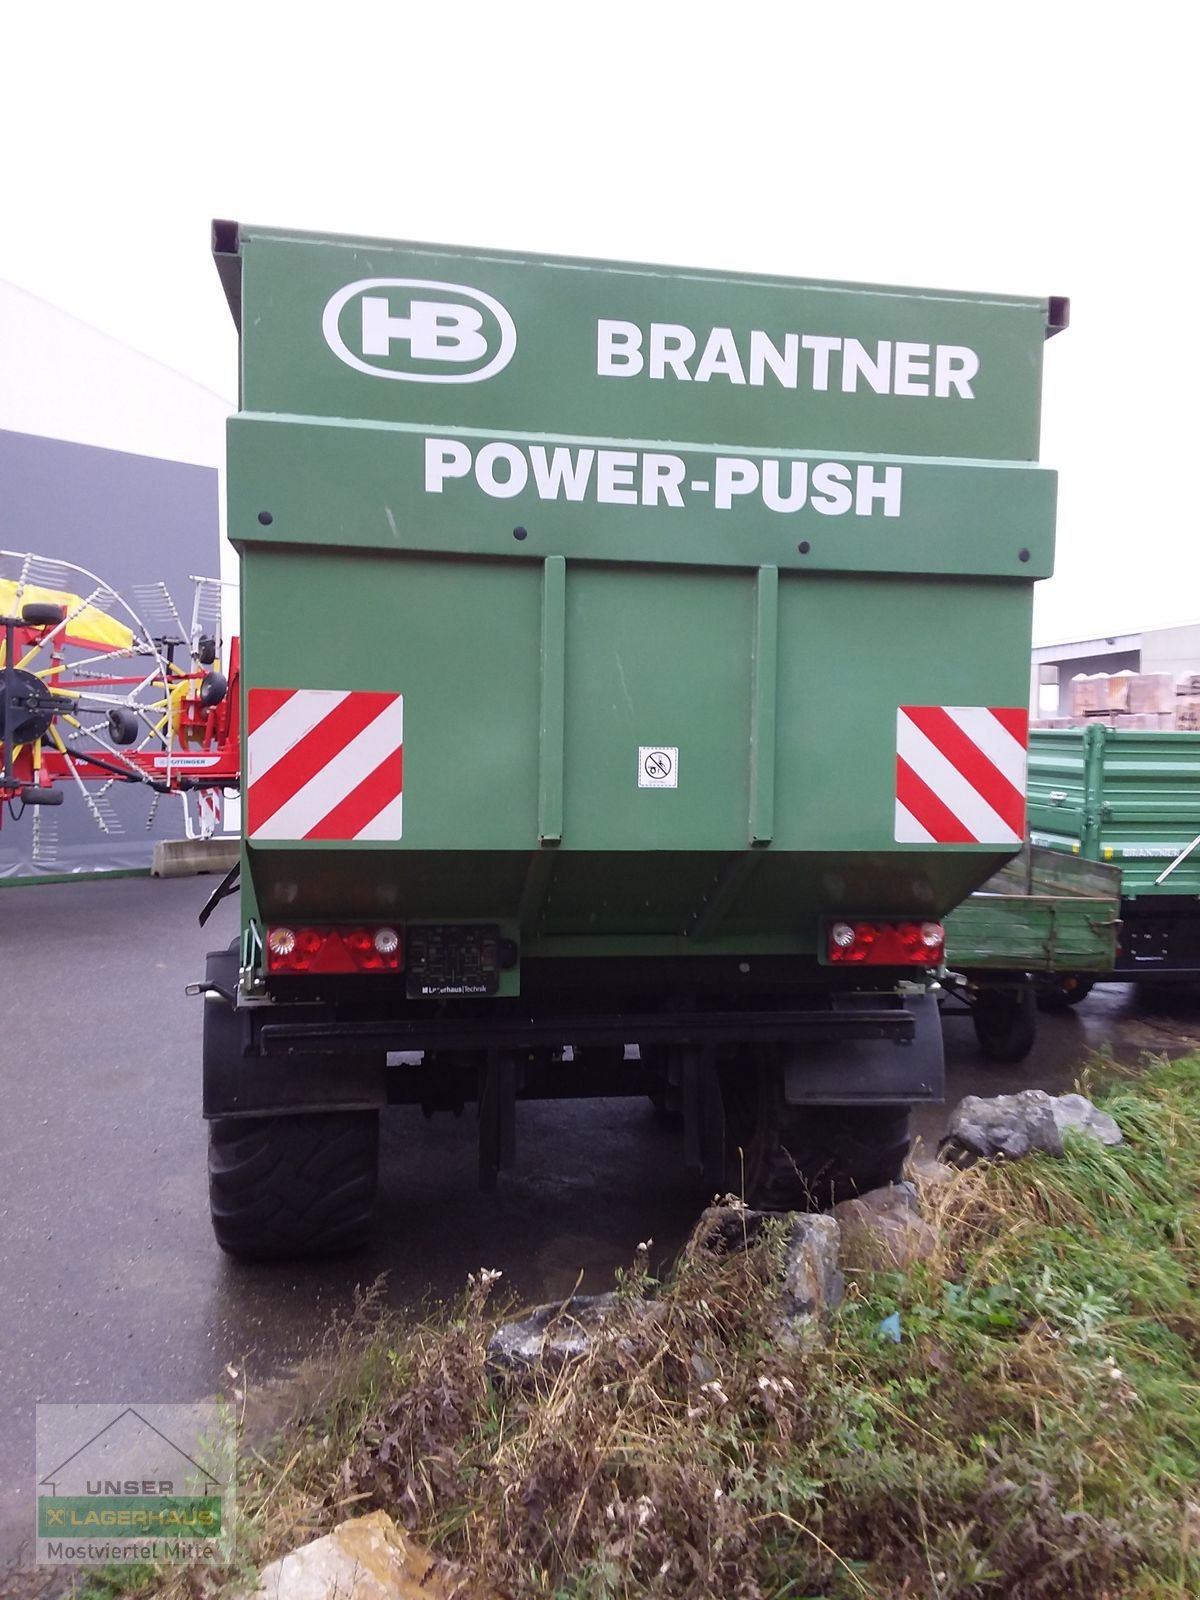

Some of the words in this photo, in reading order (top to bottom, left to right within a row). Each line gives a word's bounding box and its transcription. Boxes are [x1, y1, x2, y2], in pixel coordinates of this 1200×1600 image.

[362, 296, 487, 362] HB
[596, 319, 980, 400] BRANTNER
[424, 437, 903, 517] POWER-PUSH
